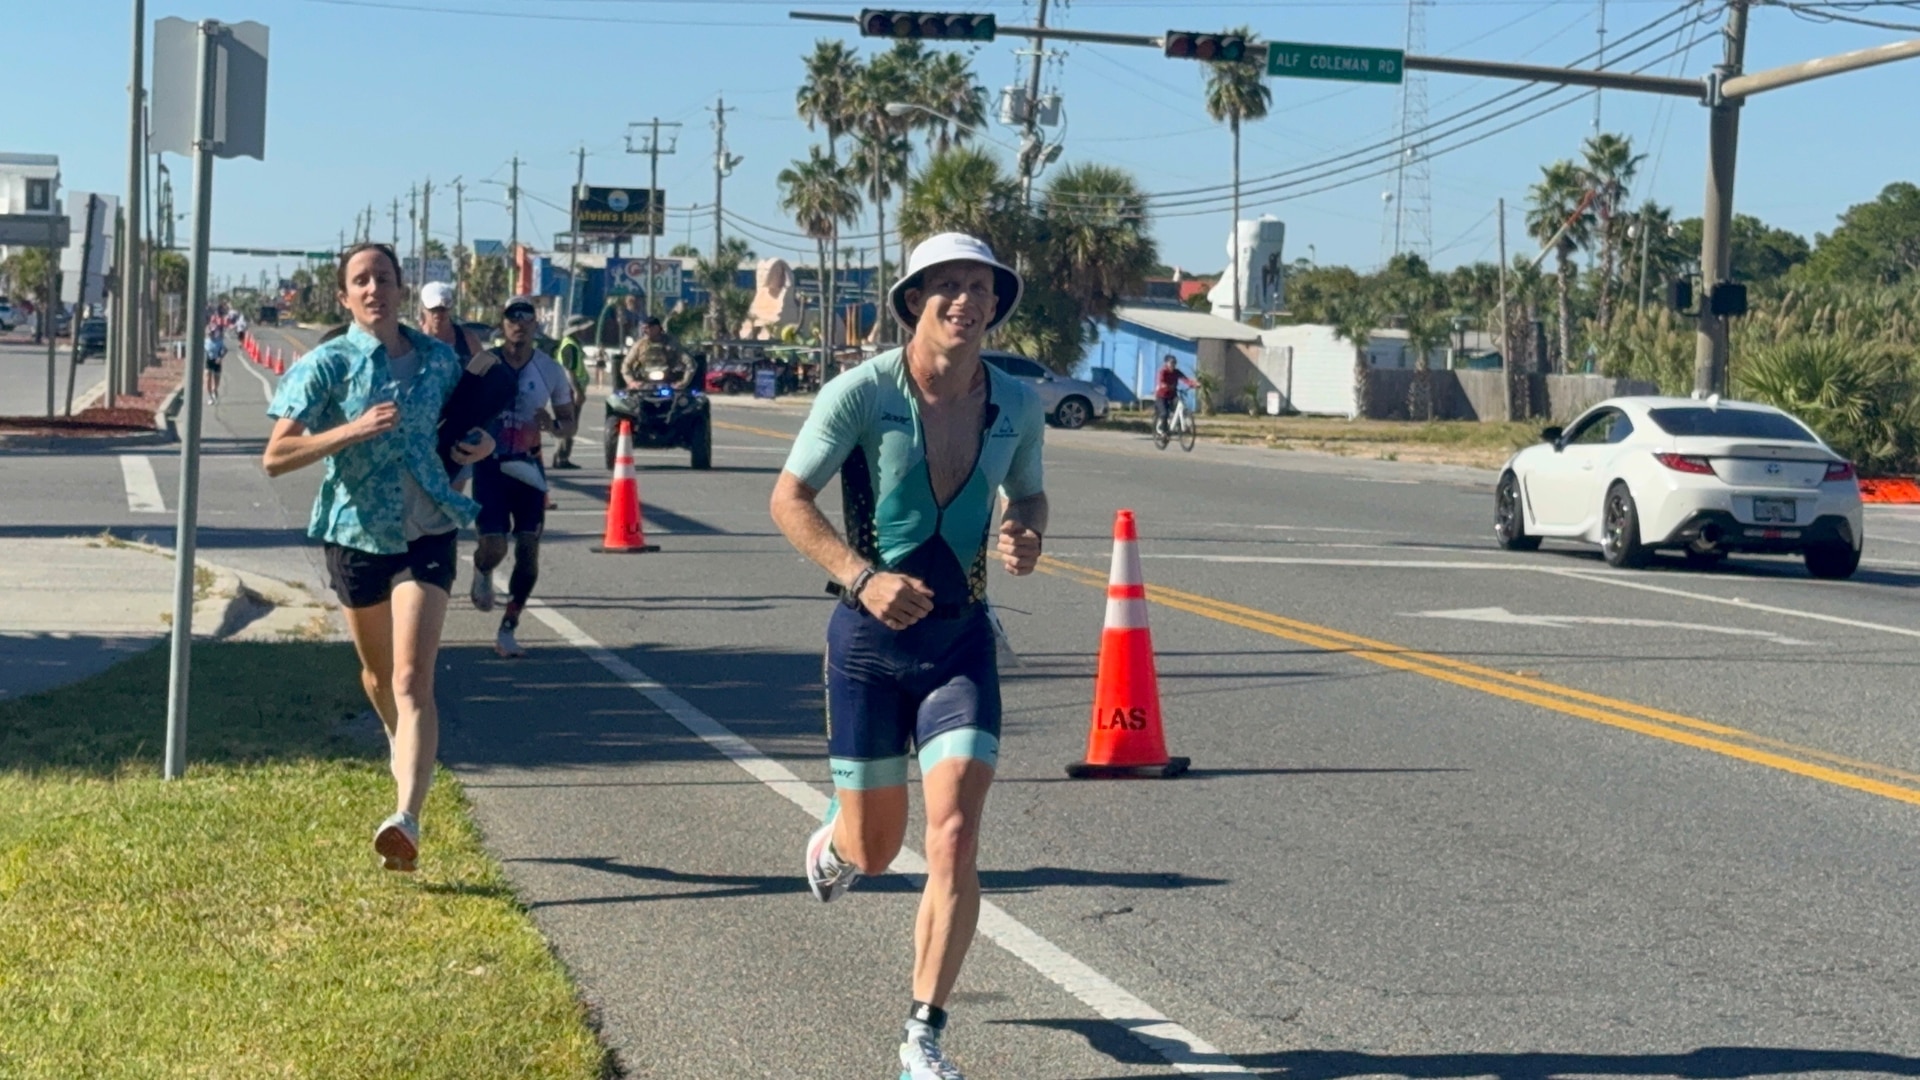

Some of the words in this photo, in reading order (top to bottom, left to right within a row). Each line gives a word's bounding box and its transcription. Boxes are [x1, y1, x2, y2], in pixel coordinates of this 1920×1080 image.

[1276, 53, 1300, 67] ALF
[1310, 55, 1369, 72] COLEMAN
[1379, 59, 1395, 74] RD
[623, 211, 664, 224] Islad
[1098, 706, 1147, 731] LAS
